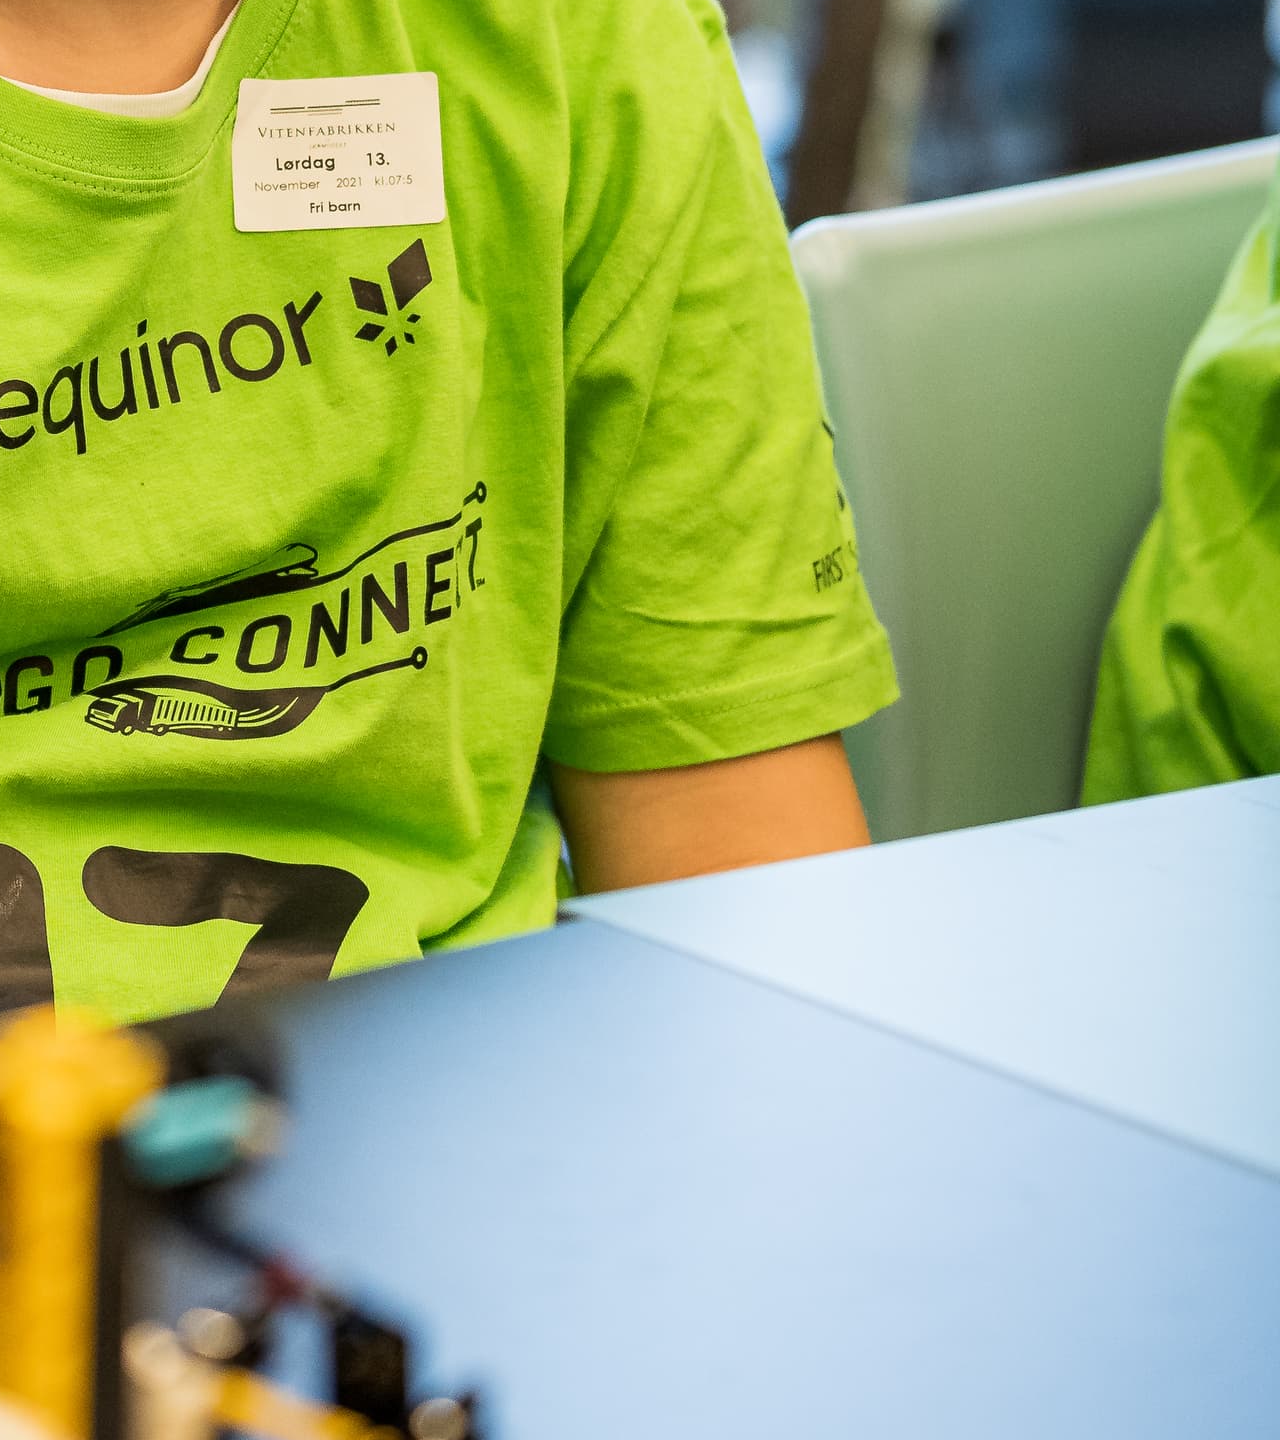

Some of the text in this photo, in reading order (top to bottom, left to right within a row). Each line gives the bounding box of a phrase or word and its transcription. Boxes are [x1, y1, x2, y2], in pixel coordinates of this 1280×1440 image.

[257, 122, 396, 139] VITENFABRIKKEN
[276, 152, 390, 171] Lørdag 13.
[254, 180, 320, 193] November
[336, 176, 363, 188] 2021
[309, 201, 361, 214] Fri barn
[169, 517, 482, 674] CONNET
